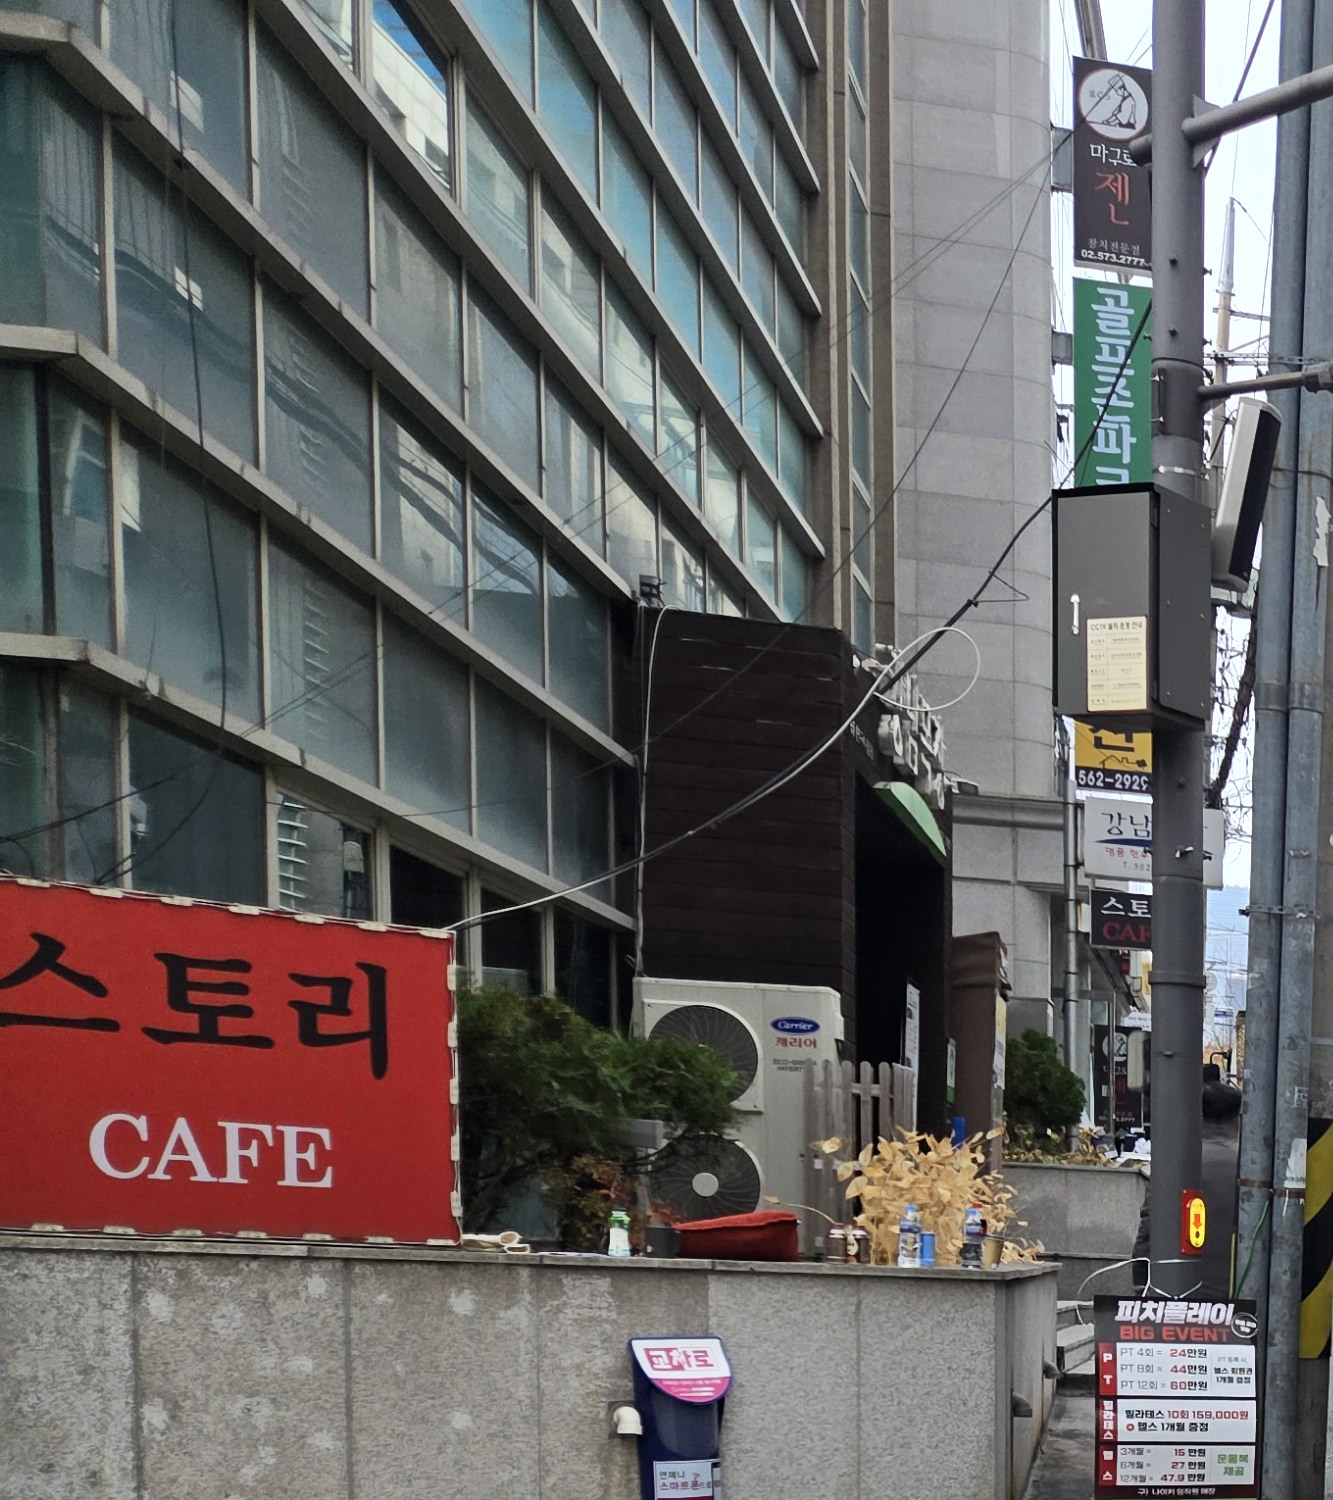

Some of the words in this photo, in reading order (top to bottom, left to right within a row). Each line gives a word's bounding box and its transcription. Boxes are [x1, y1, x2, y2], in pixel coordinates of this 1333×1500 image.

[0, 931, 388, 1080] 스토리
[777, 1020, 813, 1030] Carrier
[775, 1036, 817, 1049] 캐리어
[89, 1112, 333, 1188] CAFE
[1115, 1300, 1235, 1325] 피치플레이
[1120, 1326, 1154, 1340] BIG
[1161, 1326, 1231, 1342] EVENT
[1120, 1347, 1135, 1357] PT
[1137, 1347, 1154, 1358] 4회
[1169, 1348, 1208, 1359] 24만원
[645, 1348, 715, 1370] 교차로
[1120, 1363, 1135, 1373] PT
[1137, 1363, 1154, 1374] 8회
[1170, 1364, 1208, 1375] 44만원
[1120, 1380, 1135, 1390] PT
[1138, 1380, 1158, 1390] 12회
[1170, 1381, 1208, 1391] 60만원
[1167, 1410, 1189, 1420] 10회
[1161, 1421, 1185, 1432] 1개월
[1120, 1447, 1144, 1456] 3개월
[1174, 1448, 1186, 1457] 15
[1188, 1448, 1206, 1458] 만원
[1120, 1461, 1144, 1470] 6개월
[1171, 1461, 1186, 1470] 27
[1188, 1461, 1206, 1470] 만원
[1120, 1474, 1147, 1483] 12개월
[1161, 1474, 1185, 1483] 47.9
[1187, 1473, 1206, 1483] 만원
[1151, 1488, 1175, 1496] 나이키
